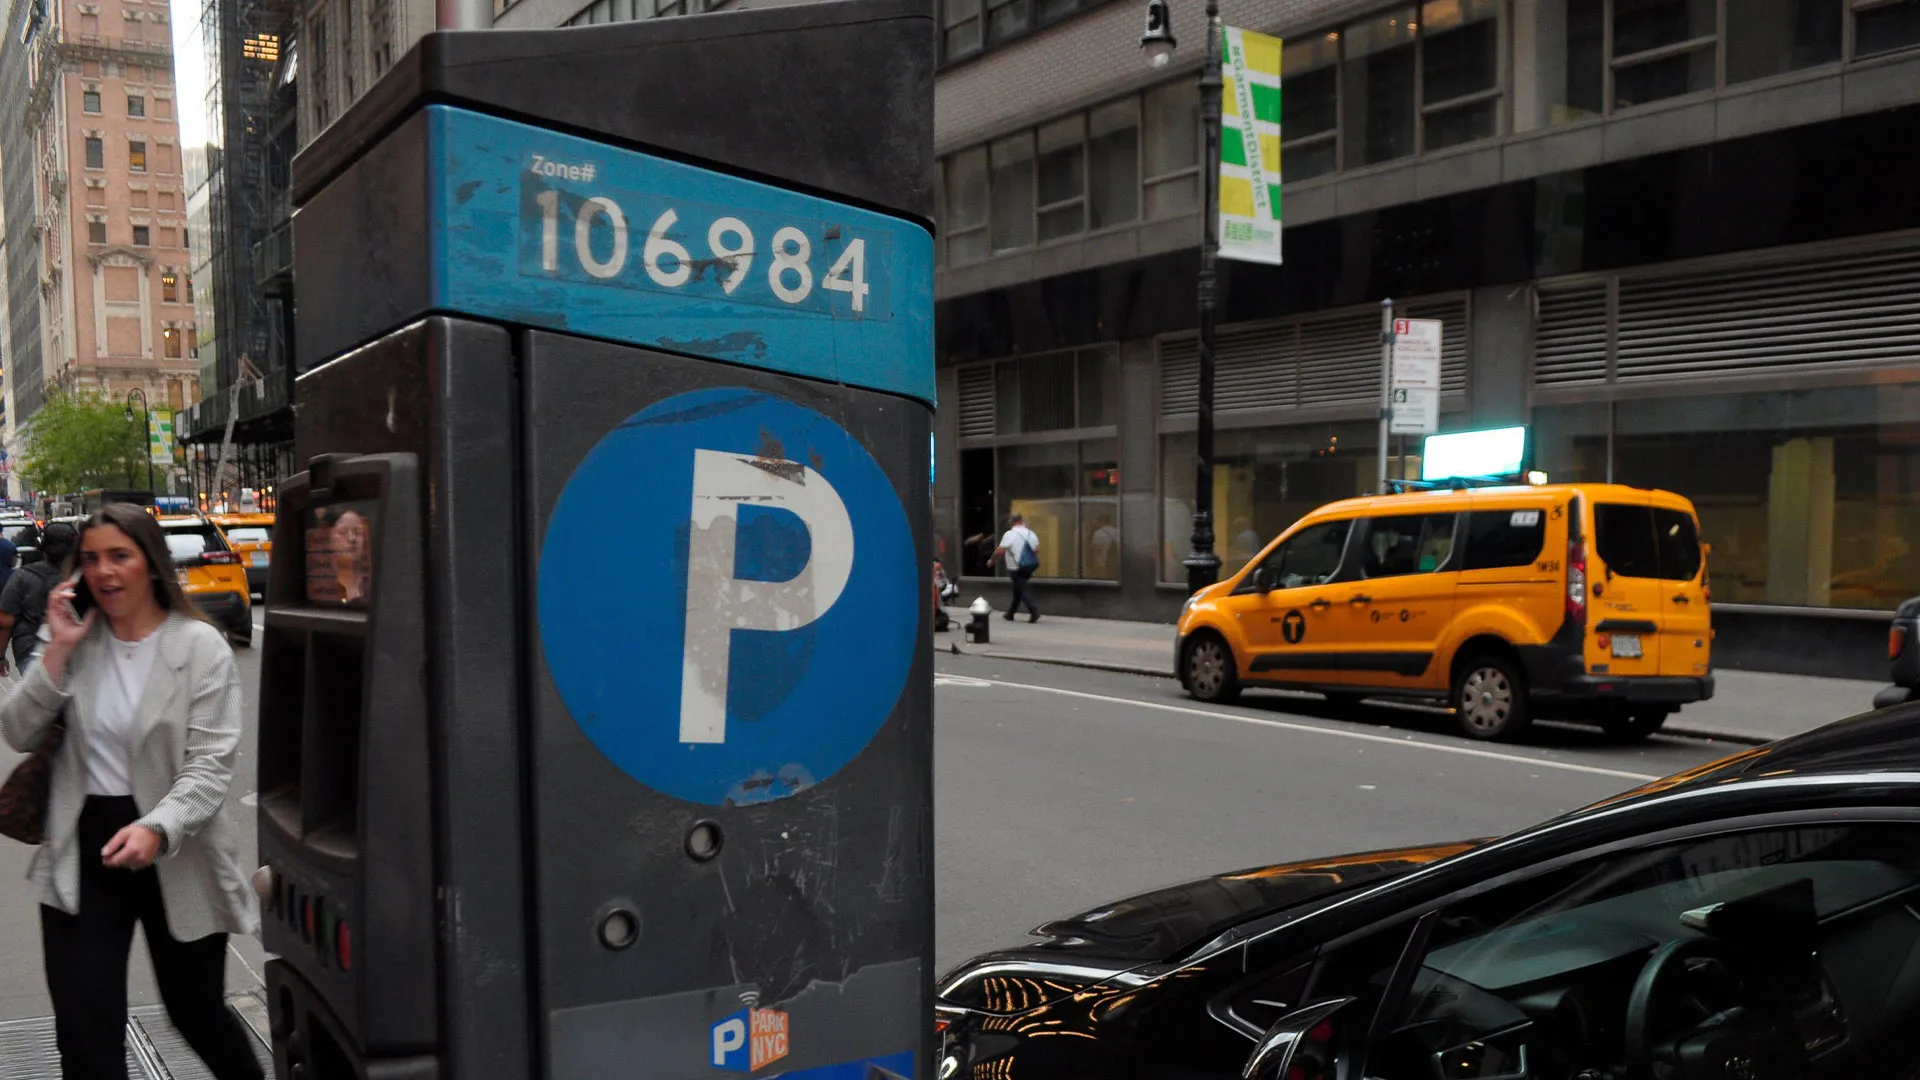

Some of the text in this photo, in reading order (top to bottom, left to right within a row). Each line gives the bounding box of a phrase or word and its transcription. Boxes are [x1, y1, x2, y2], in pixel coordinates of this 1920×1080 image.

[530, 155, 596, 183] Zone#
[537, 190, 869, 312] 106984
[679, 448, 855, 744] P
[1286, 616, 1301, 640] T
[752, 1011, 784, 1032] PARK
[713, 1018, 745, 1066] P
[752, 1033, 786, 1065] NYC
